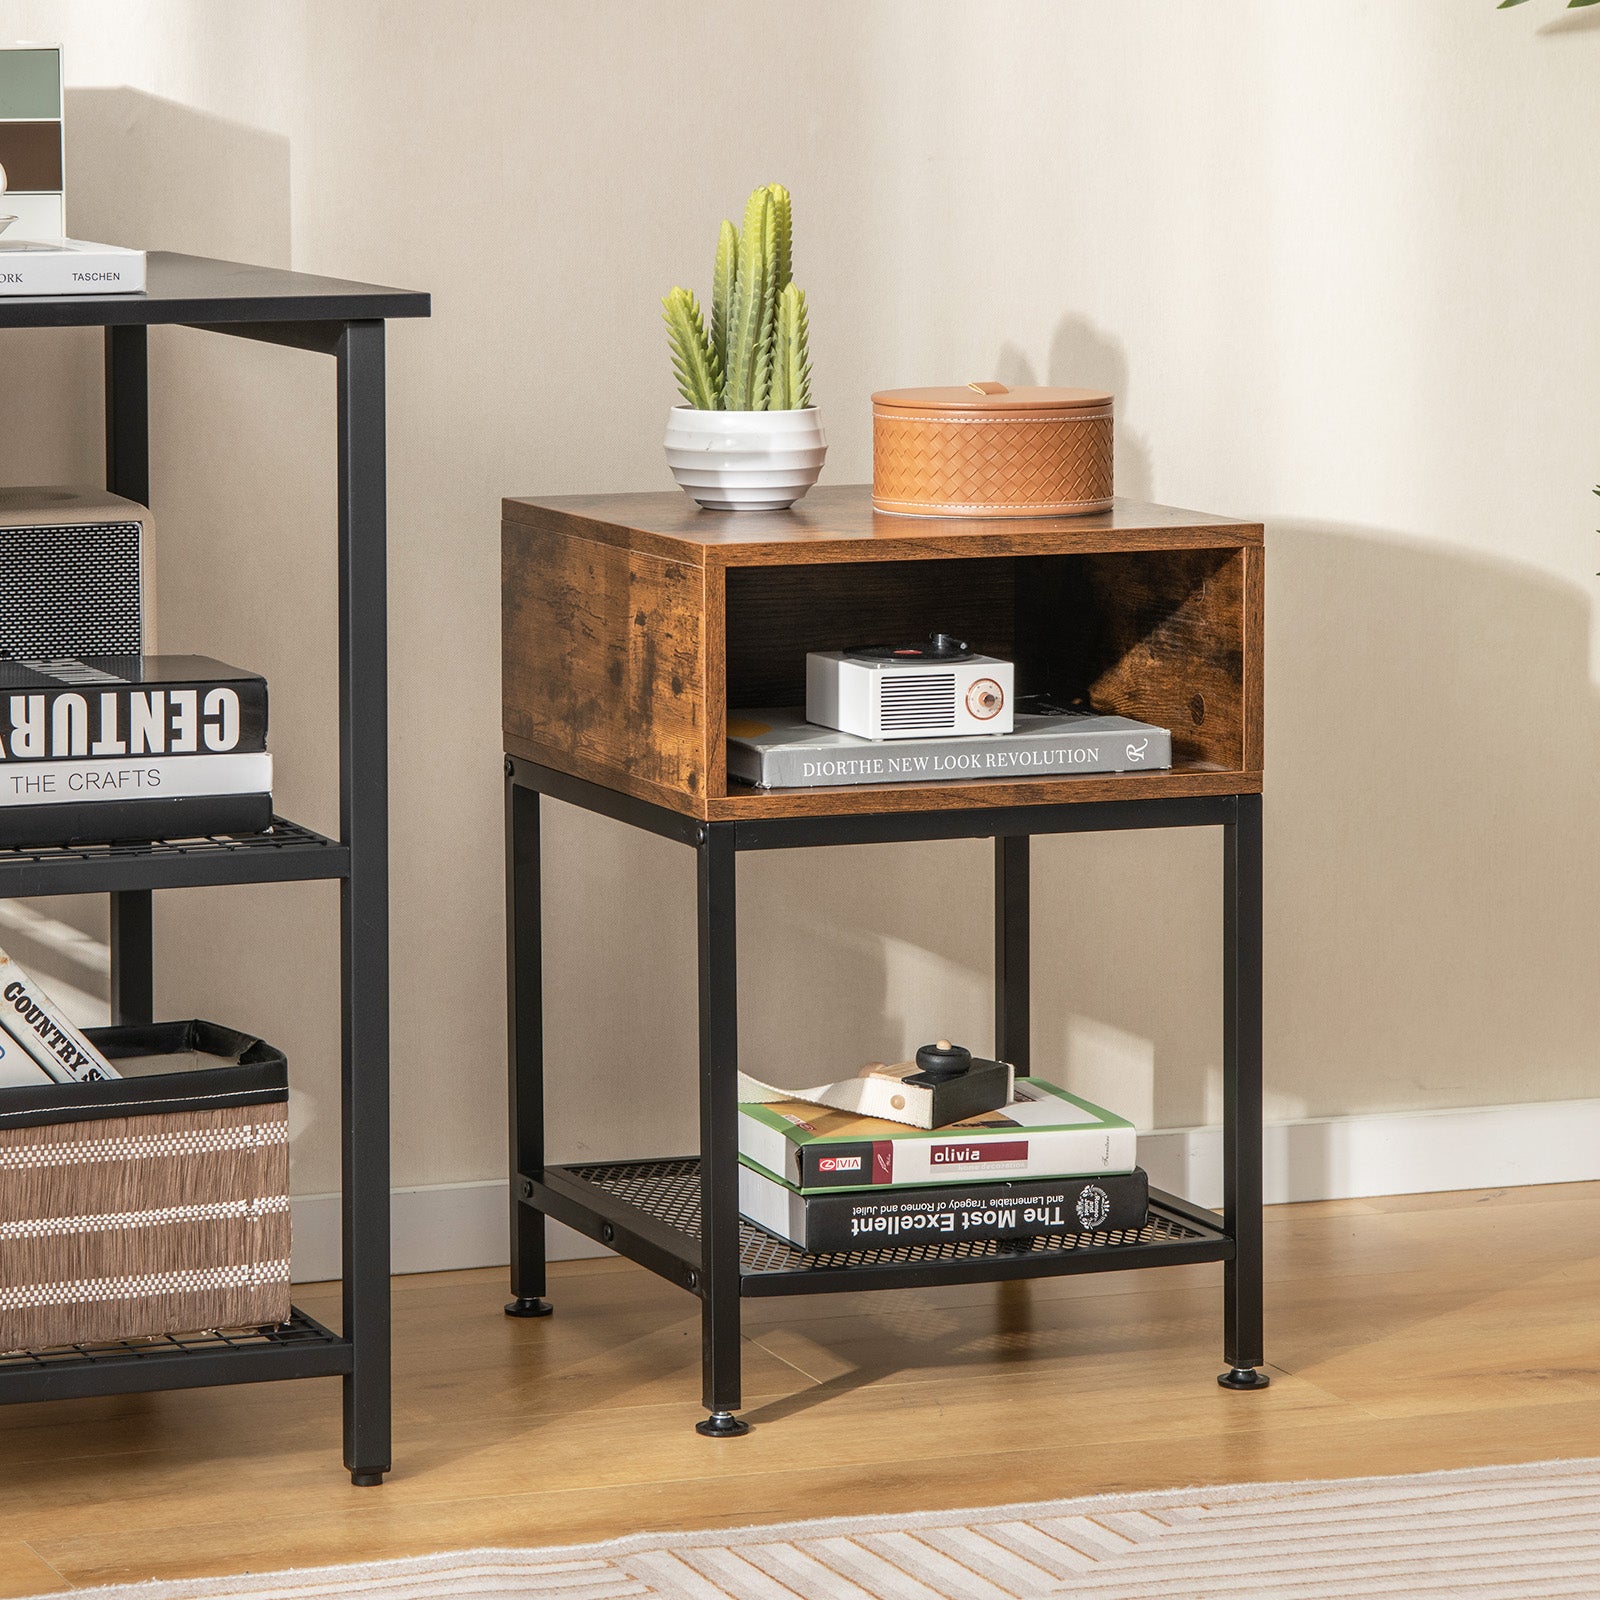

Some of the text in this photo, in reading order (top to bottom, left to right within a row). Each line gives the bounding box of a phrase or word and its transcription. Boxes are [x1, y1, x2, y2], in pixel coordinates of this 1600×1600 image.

[72, 272, 120, 281] TASCHEN
[0, 688, 240, 759] CENTUR
[888, 756, 929, 772] NEW
[934, 754, 982, 770] LOOK
[986, 748, 1100, 767] REVOLUTION
[10, 769, 161, 794] THE CRAFTS
[3, 981, 89, 1073] COUNTRY
[934, 1146, 980, 1162] olivia
[852, 1195, 1064, 1216] and Lamentable Tragedy of Romeo and Juliet
[851, 1206, 1065, 1237] The Most Excellent
